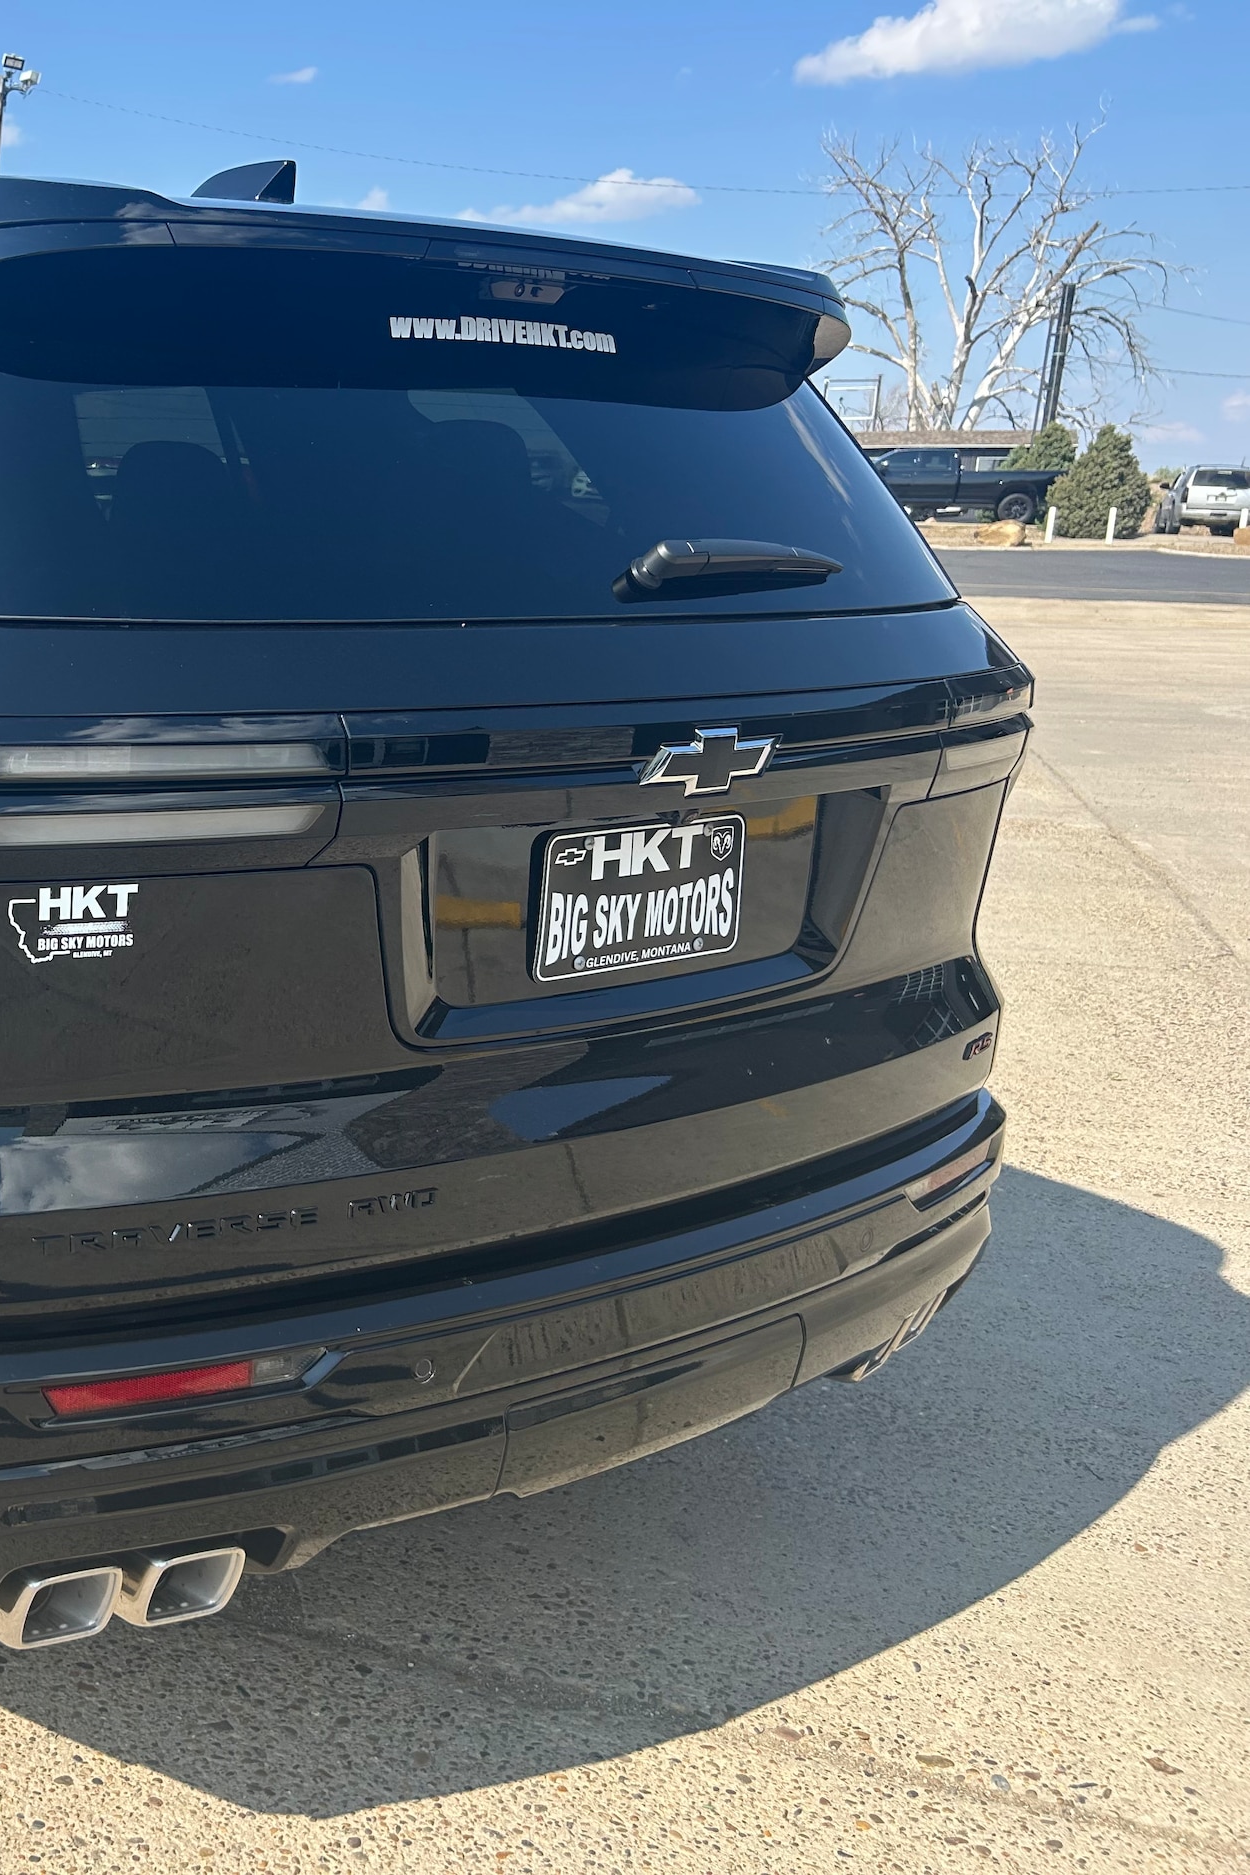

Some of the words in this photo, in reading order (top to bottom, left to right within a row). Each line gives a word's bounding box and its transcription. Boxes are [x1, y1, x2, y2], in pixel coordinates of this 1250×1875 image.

[389, 315, 617, 354] www.DRIVEHKT.com
[591, 824, 705, 881] HKT
[38, 883, 139, 922] HKT
[544, 891, 589, 966] BIG
[592, 892, 643, 950] SKY
[643, 867, 735, 938] MOTORS
[37, 937, 59, 951] BIG
[60, 935, 84, 950] SKY
[85, 933, 134, 949] MOTORS
[585, 949, 640, 969] GLENDIVE,
[641, 941, 692, 960] MONTANA
[962, 1031, 994, 1061] RS
[31, 1205, 320, 1256] TRAVERSE
[347, 1186, 441, 1219] AWD
